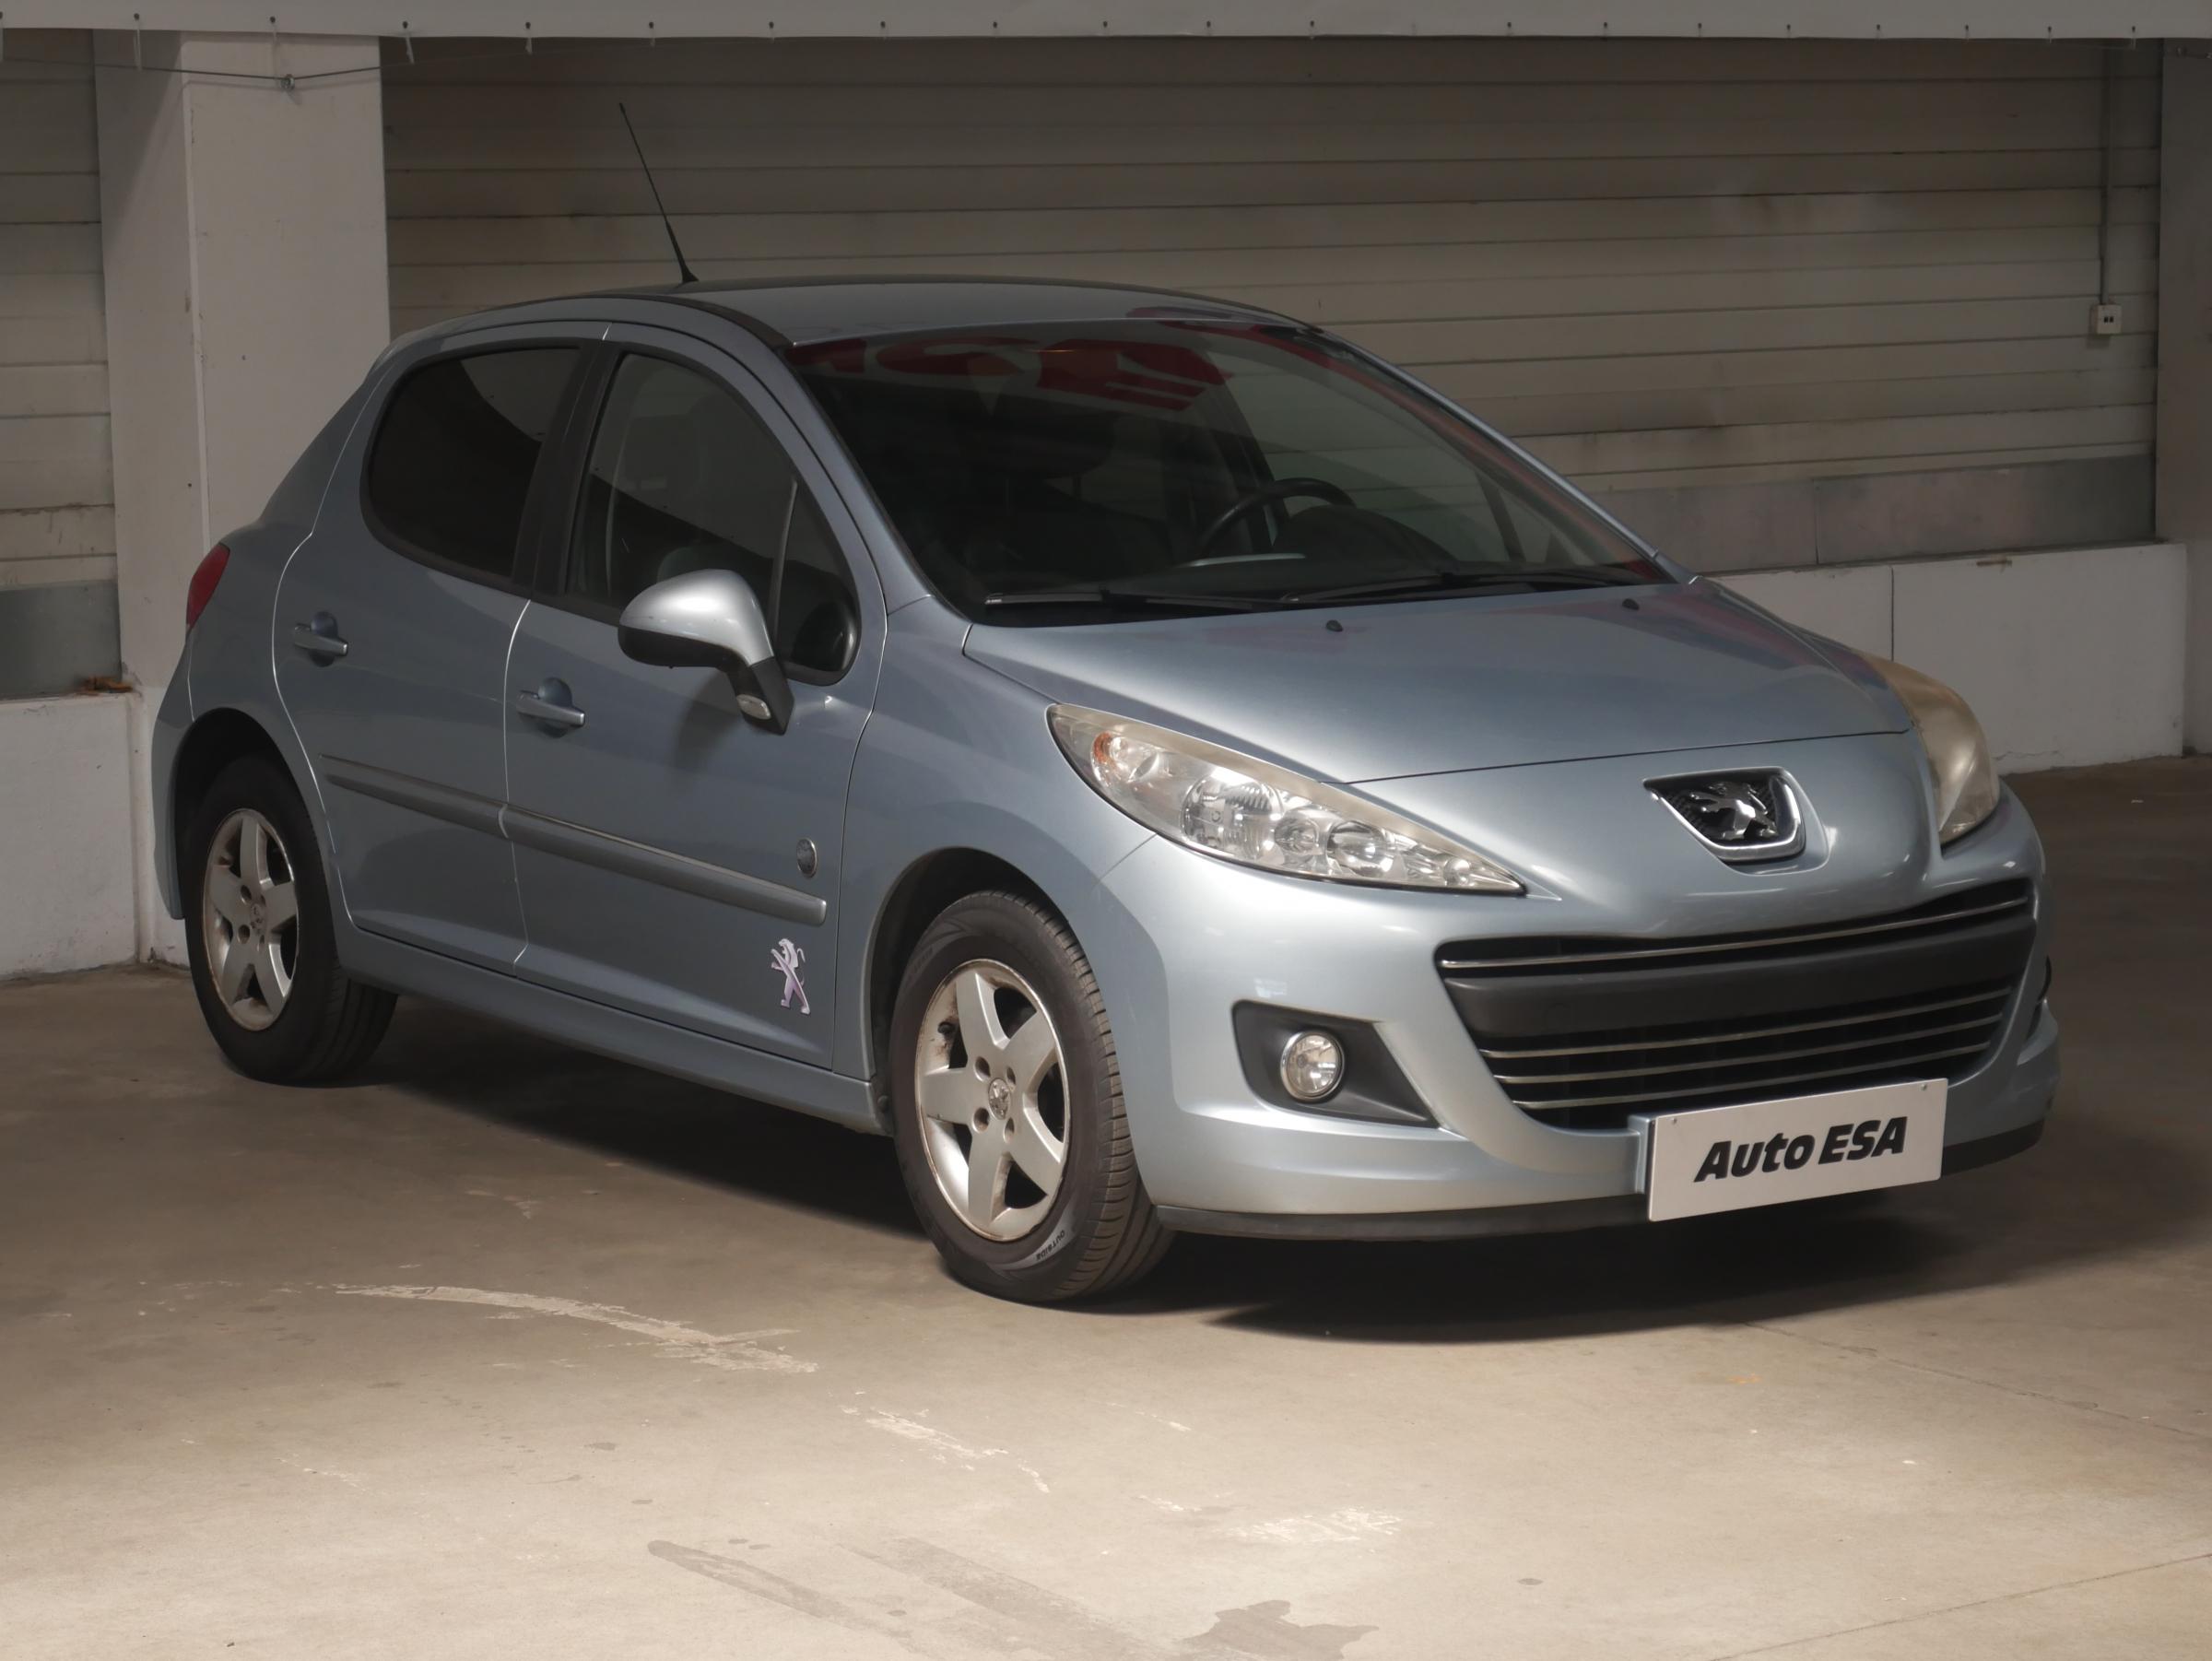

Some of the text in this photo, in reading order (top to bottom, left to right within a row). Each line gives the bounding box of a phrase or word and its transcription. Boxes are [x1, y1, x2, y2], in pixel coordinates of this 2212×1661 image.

[1694, 1116, 1908, 1183] Auto ESA
[1036, 1230, 1065, 1261] OUTSIDE
